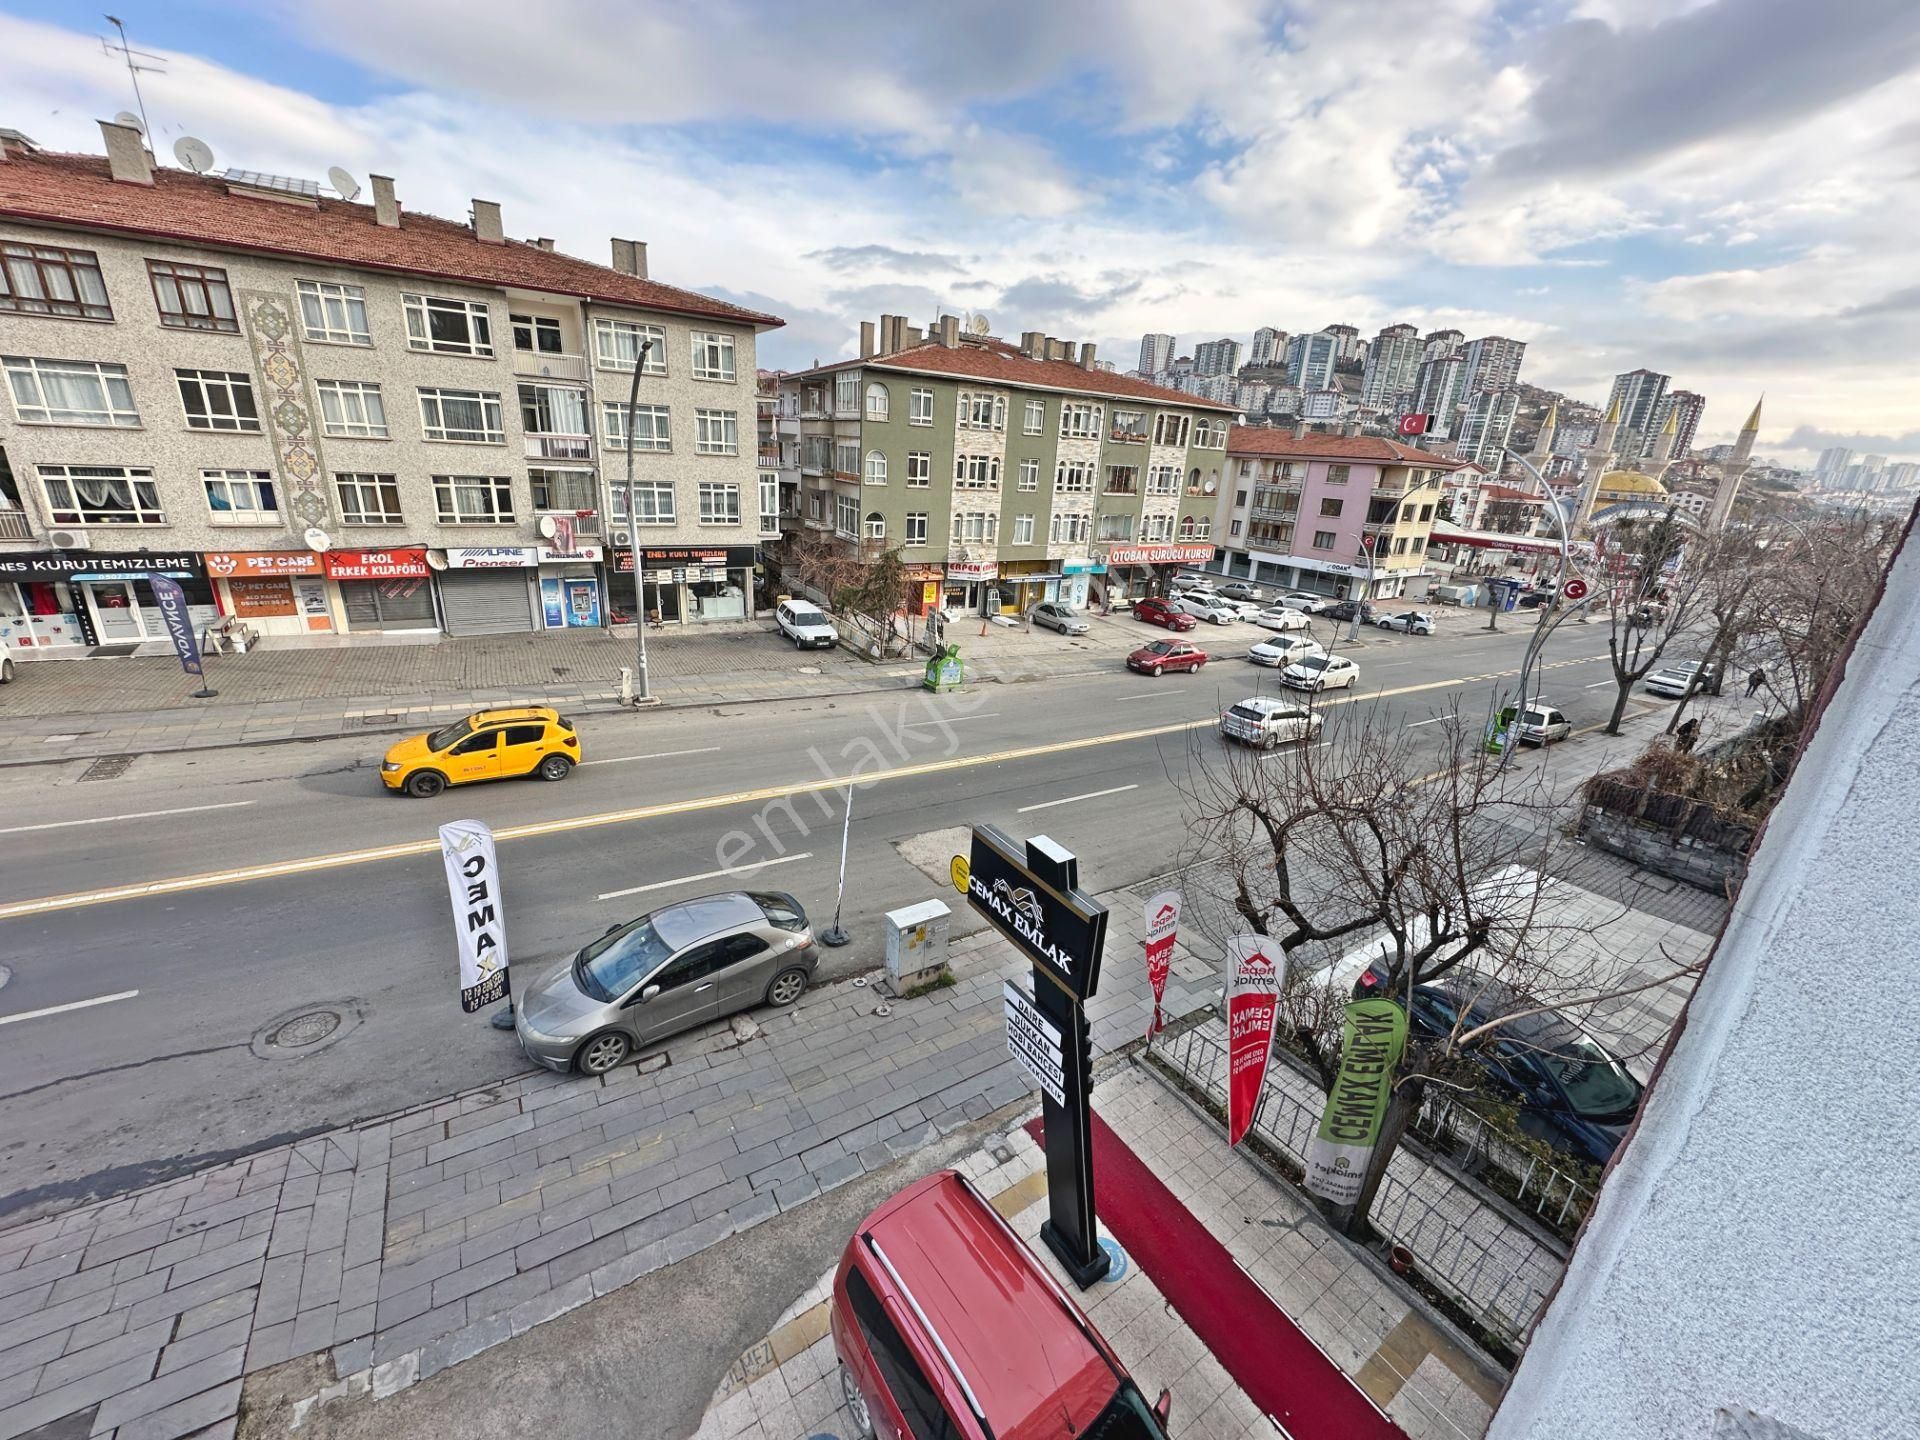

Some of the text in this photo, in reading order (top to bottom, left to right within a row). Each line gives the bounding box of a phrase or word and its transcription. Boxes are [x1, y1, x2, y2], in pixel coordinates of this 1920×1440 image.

[361, 553, 395, 564] EKOL
[480, 547, 525, 557] ALPINE
[1112, 546, 1212, 562] OTOBAN SÜRÜCÜ KURSU
[246, 555, 315, 568] PET CARE
[462, 558, 525, 567] Pioneer
[949, 562, 981, 572] ERPEN
[331, 562, 427, 577] ERKEK KUAFÖRÜ
[968, 874, 1013, 923] CEMAX
[1013, 912, 1073, 976] EMLAK
[1018, 999, 1044, 1031] DAİRE
[1008, 1022, 1026, 1046] HOBİ
[1014, 1013, 1050, 1055] DÜKKAN
